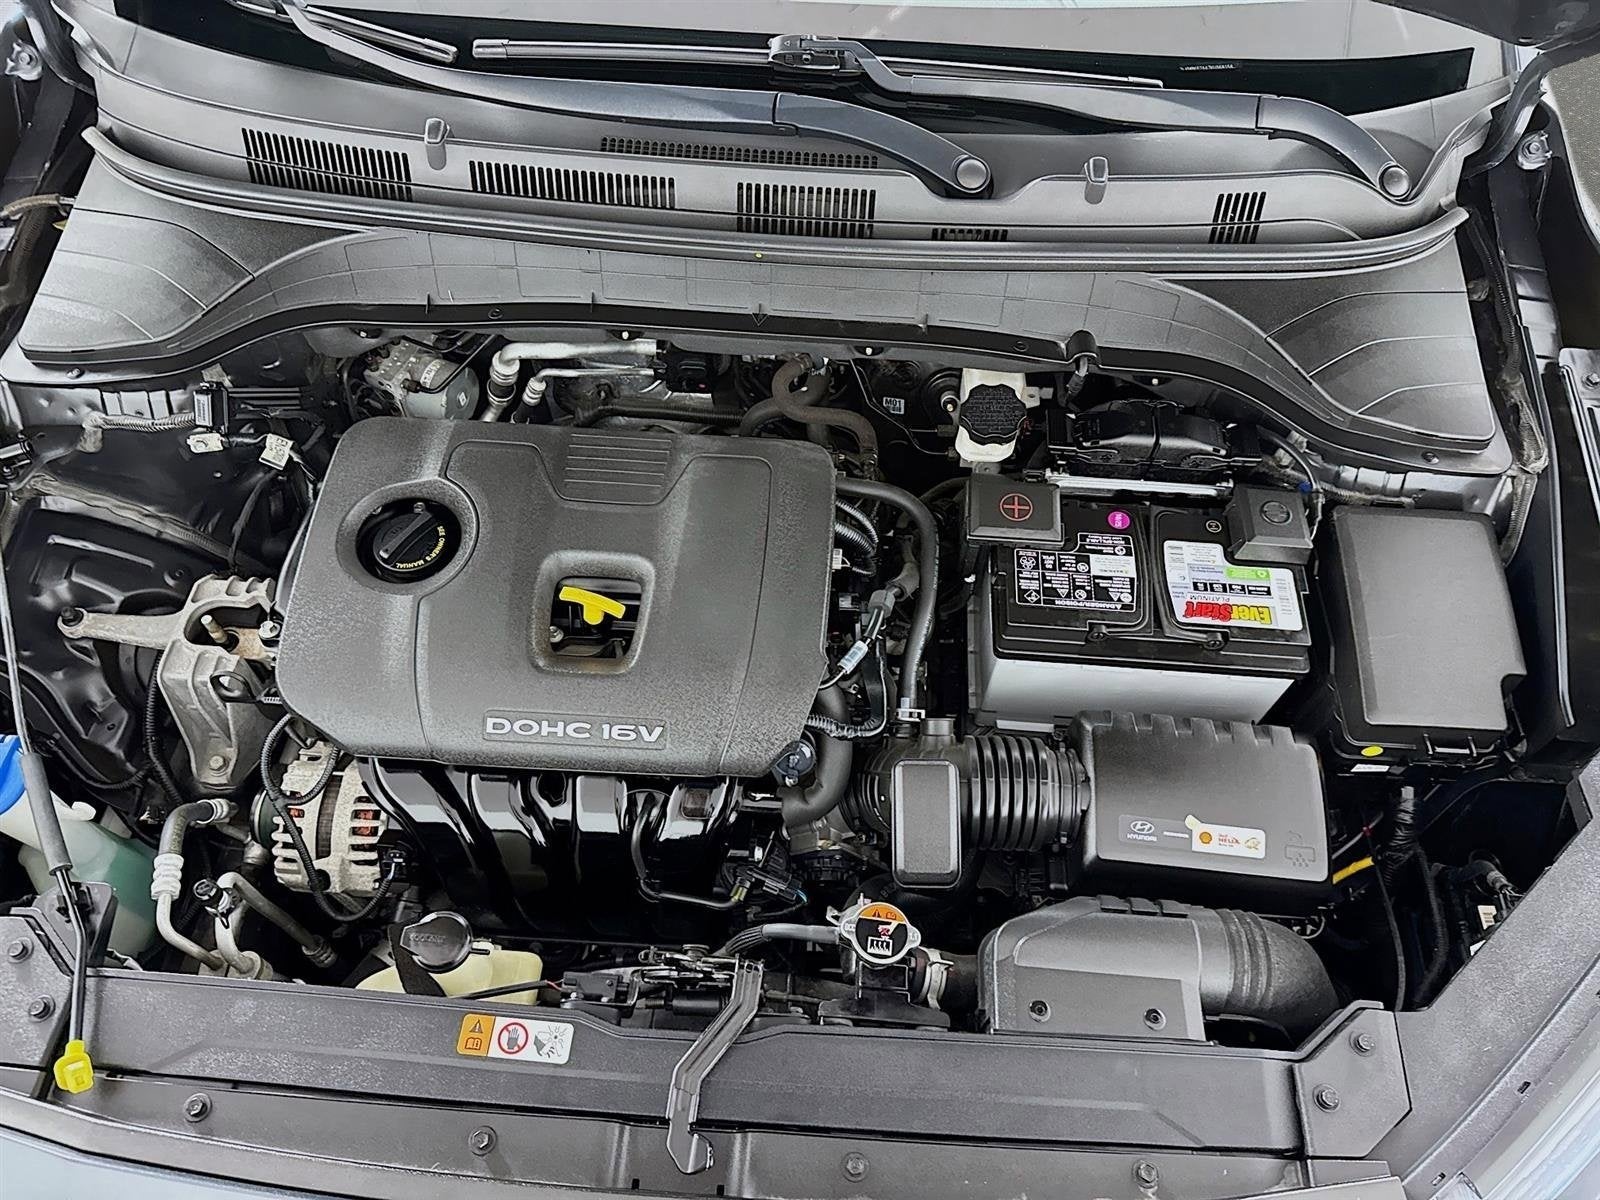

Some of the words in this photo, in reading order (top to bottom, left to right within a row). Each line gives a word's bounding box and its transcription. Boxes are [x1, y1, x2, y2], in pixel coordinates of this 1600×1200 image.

[885, 398, 901, 406] M01
[437, 526, 446, 536] SEE
[425, 537, 445, 561] OWNER'S
[396, 560, 424, 569] MANUAL
[1184, 602, 1271, 624] EverStart
[486, 717, 592, 738] DOHC
[602, 723, 664, 742] 16V
[1127, 833, 1157, 841] HYUNDAI
